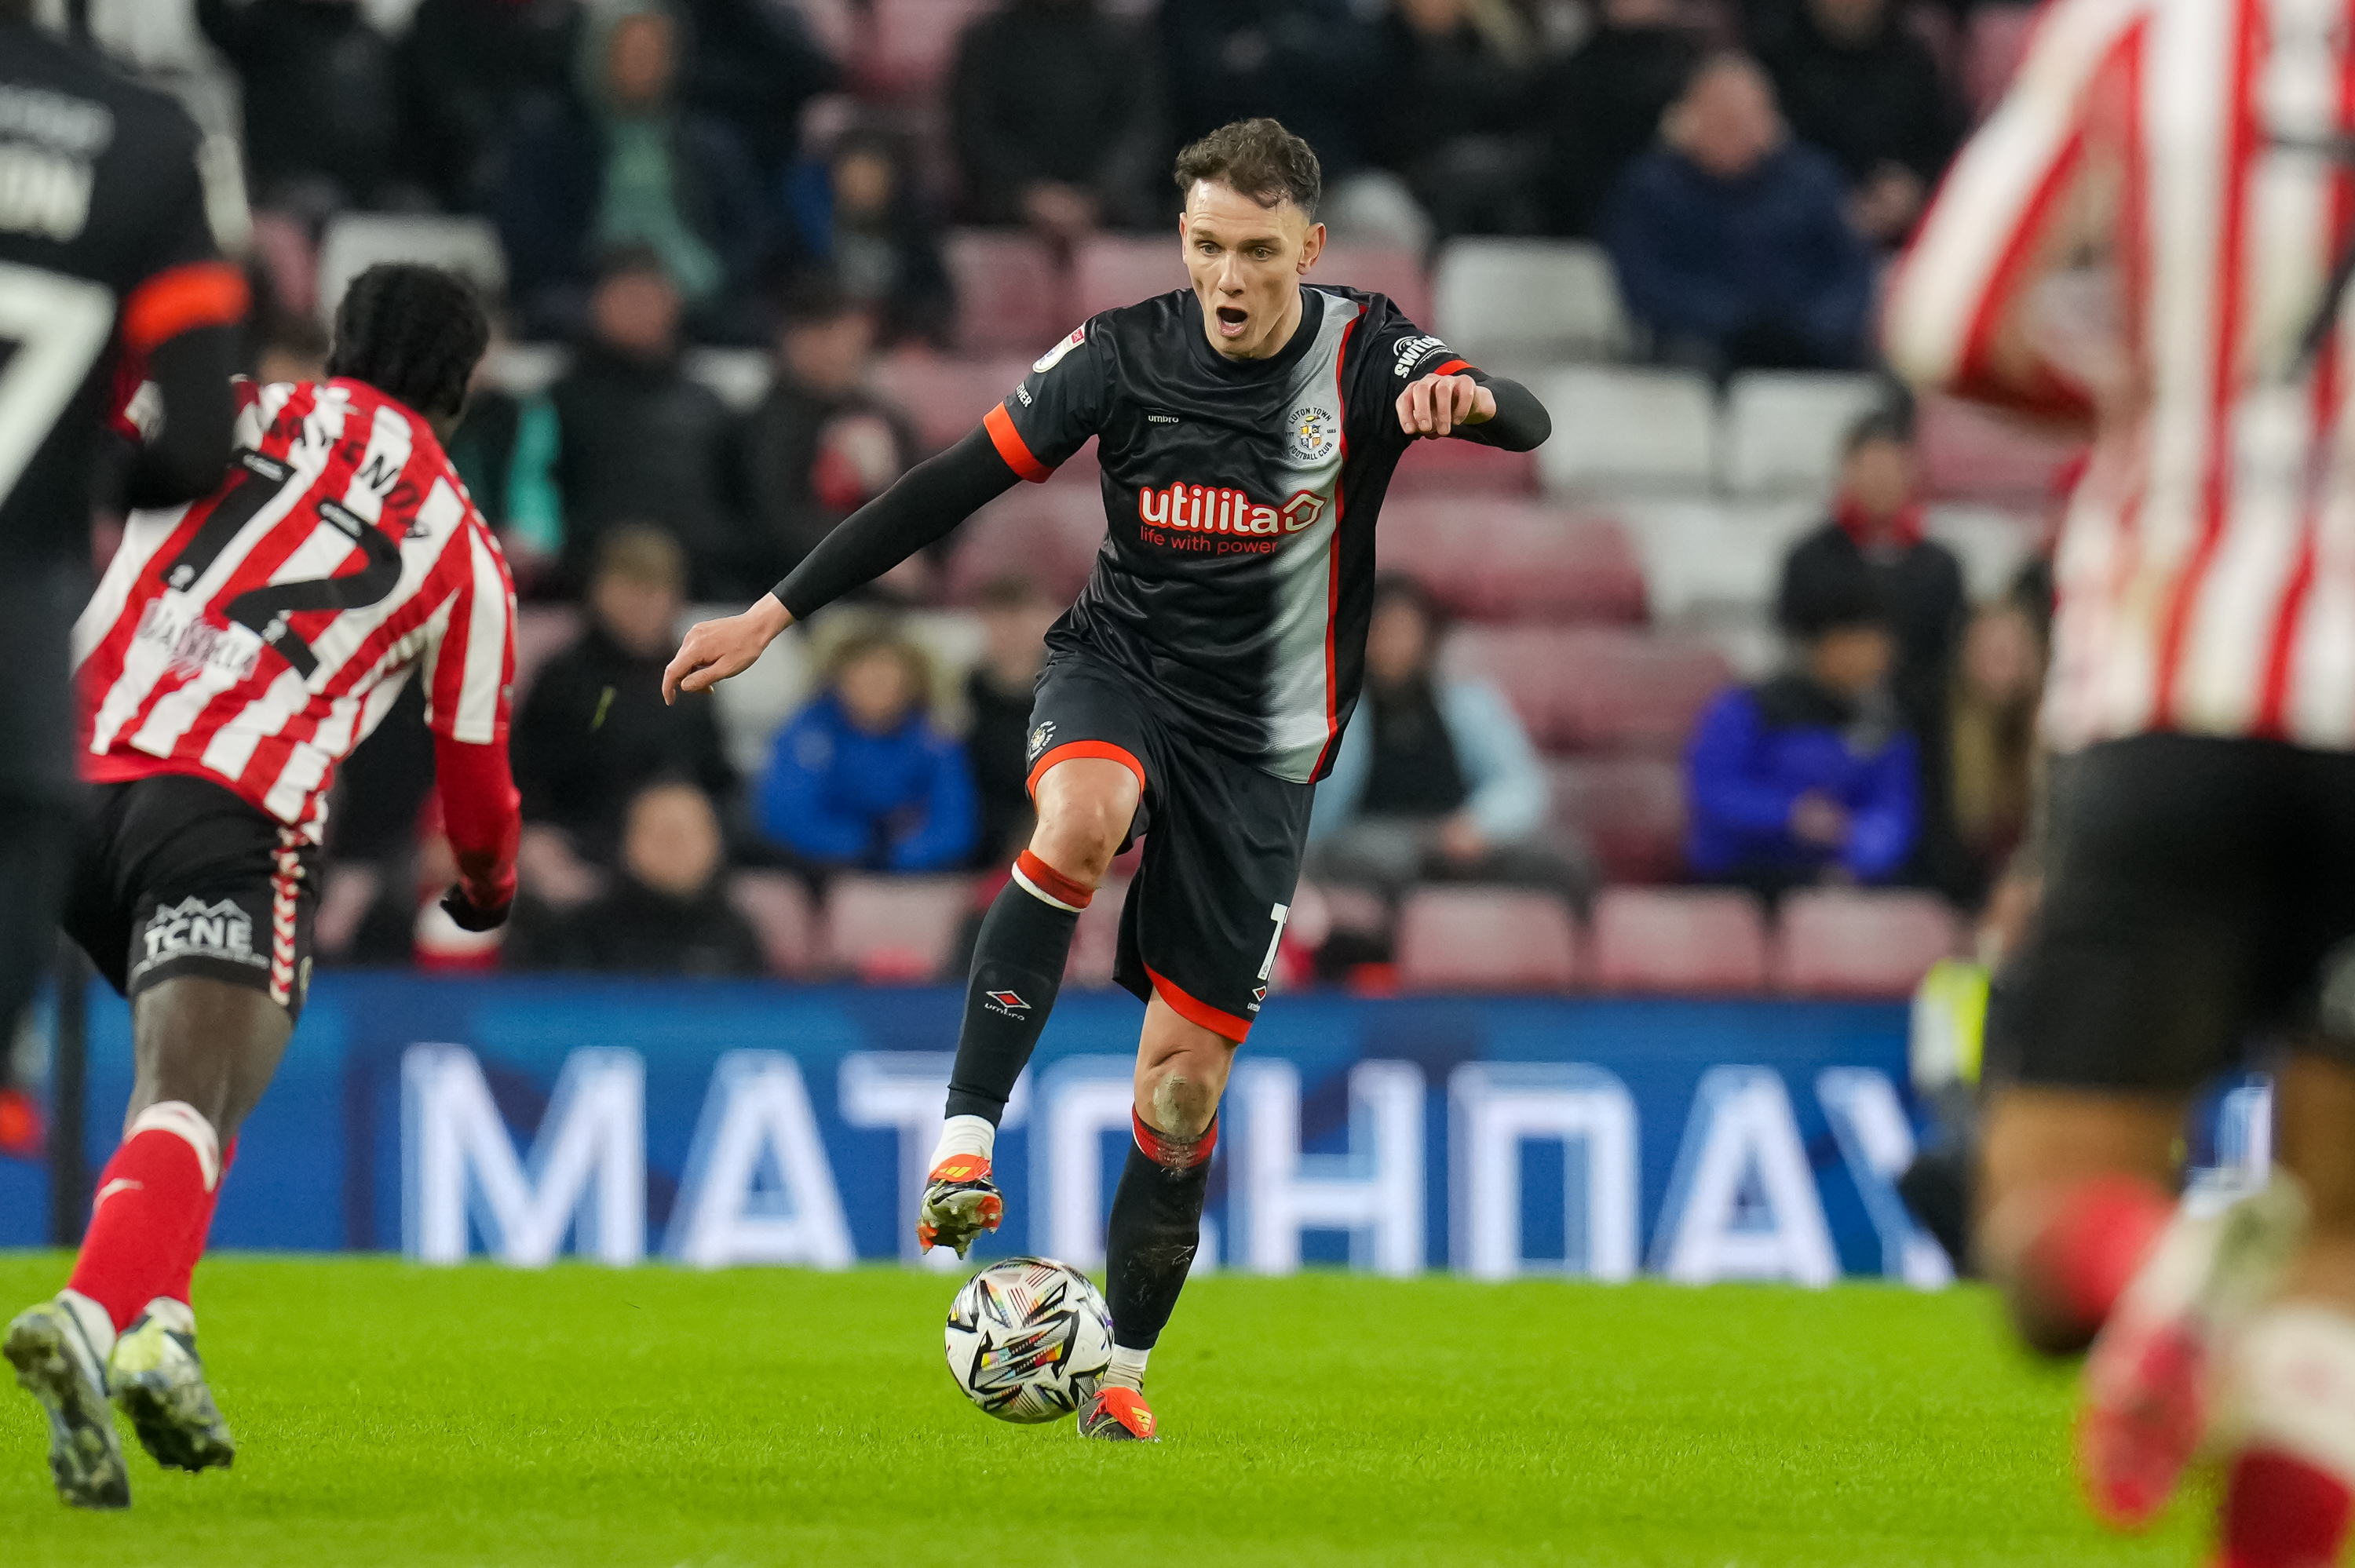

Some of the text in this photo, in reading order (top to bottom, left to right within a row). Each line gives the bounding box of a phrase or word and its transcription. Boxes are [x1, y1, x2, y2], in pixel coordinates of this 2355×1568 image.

[1288, 407, 1332, 425] LUTON TOWN
[1289, 442, 1333, 460] FOOTBALL CLUB
[1141, 483, 1280, 535] utilita
[1141, 526, 1279, 556] life with power
[162, 447, 403, 681] 12
[984, 1003, 1025, 1021] umbro
